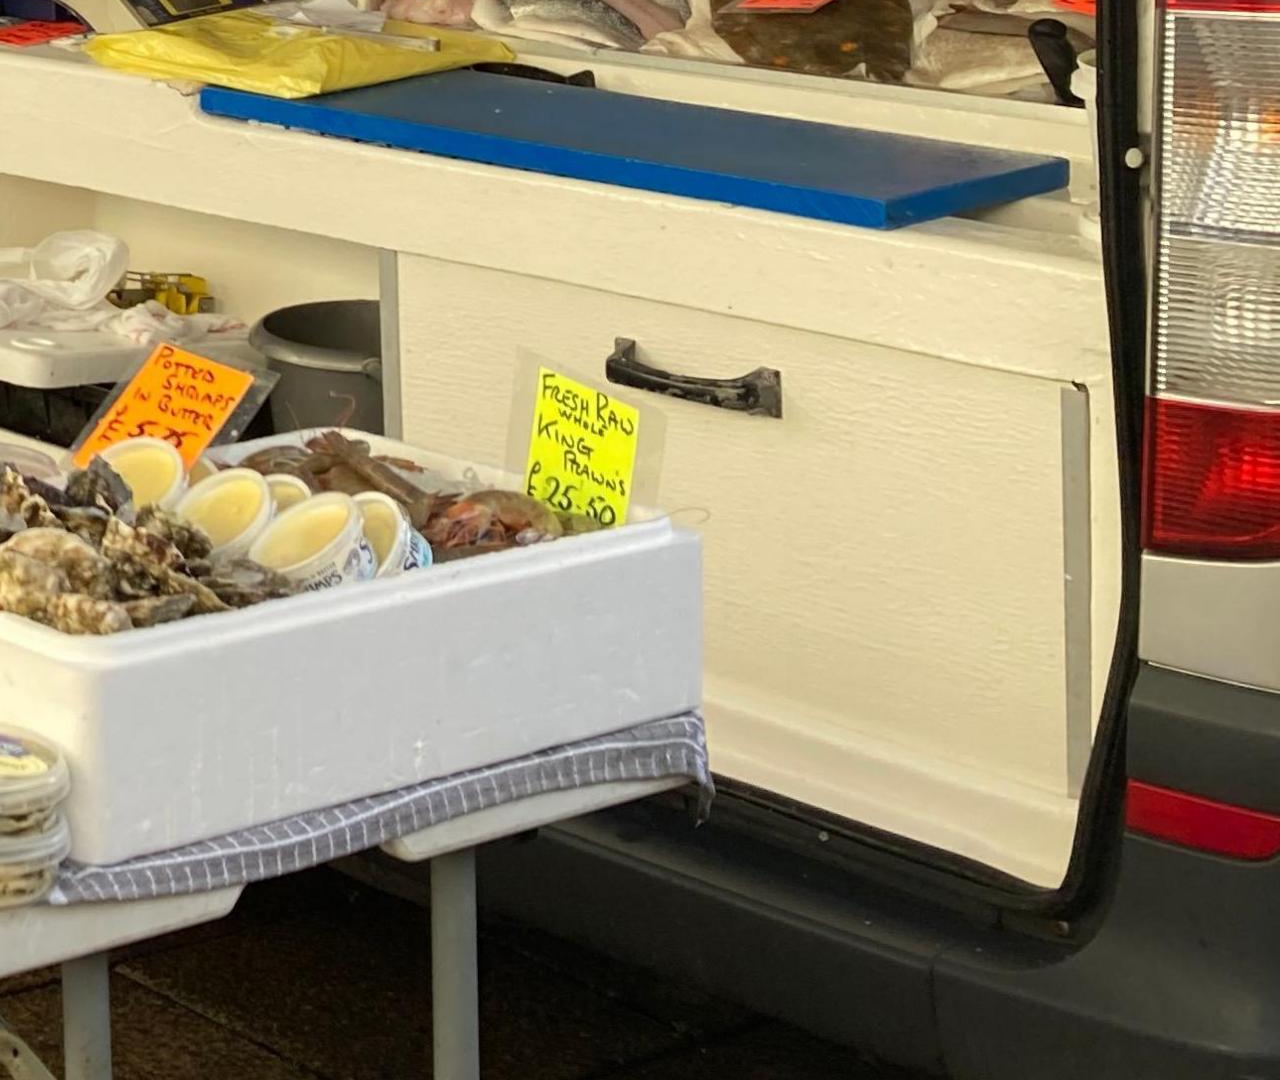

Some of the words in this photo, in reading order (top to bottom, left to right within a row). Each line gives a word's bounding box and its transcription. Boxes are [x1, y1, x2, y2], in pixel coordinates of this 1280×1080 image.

[154, 345, 216, 384] POTTED
[133, 387, 151, 402] IN
[157, 394, 216, 431] BUTTER
[161, 373, 237, 411] SHRIMPS
[542, 373, 589, 417] FRESH
[596, 391, 635, 437] RAW
[537, 412, 595, 461] KING
[557, 407, 609, 438] WHOLE
